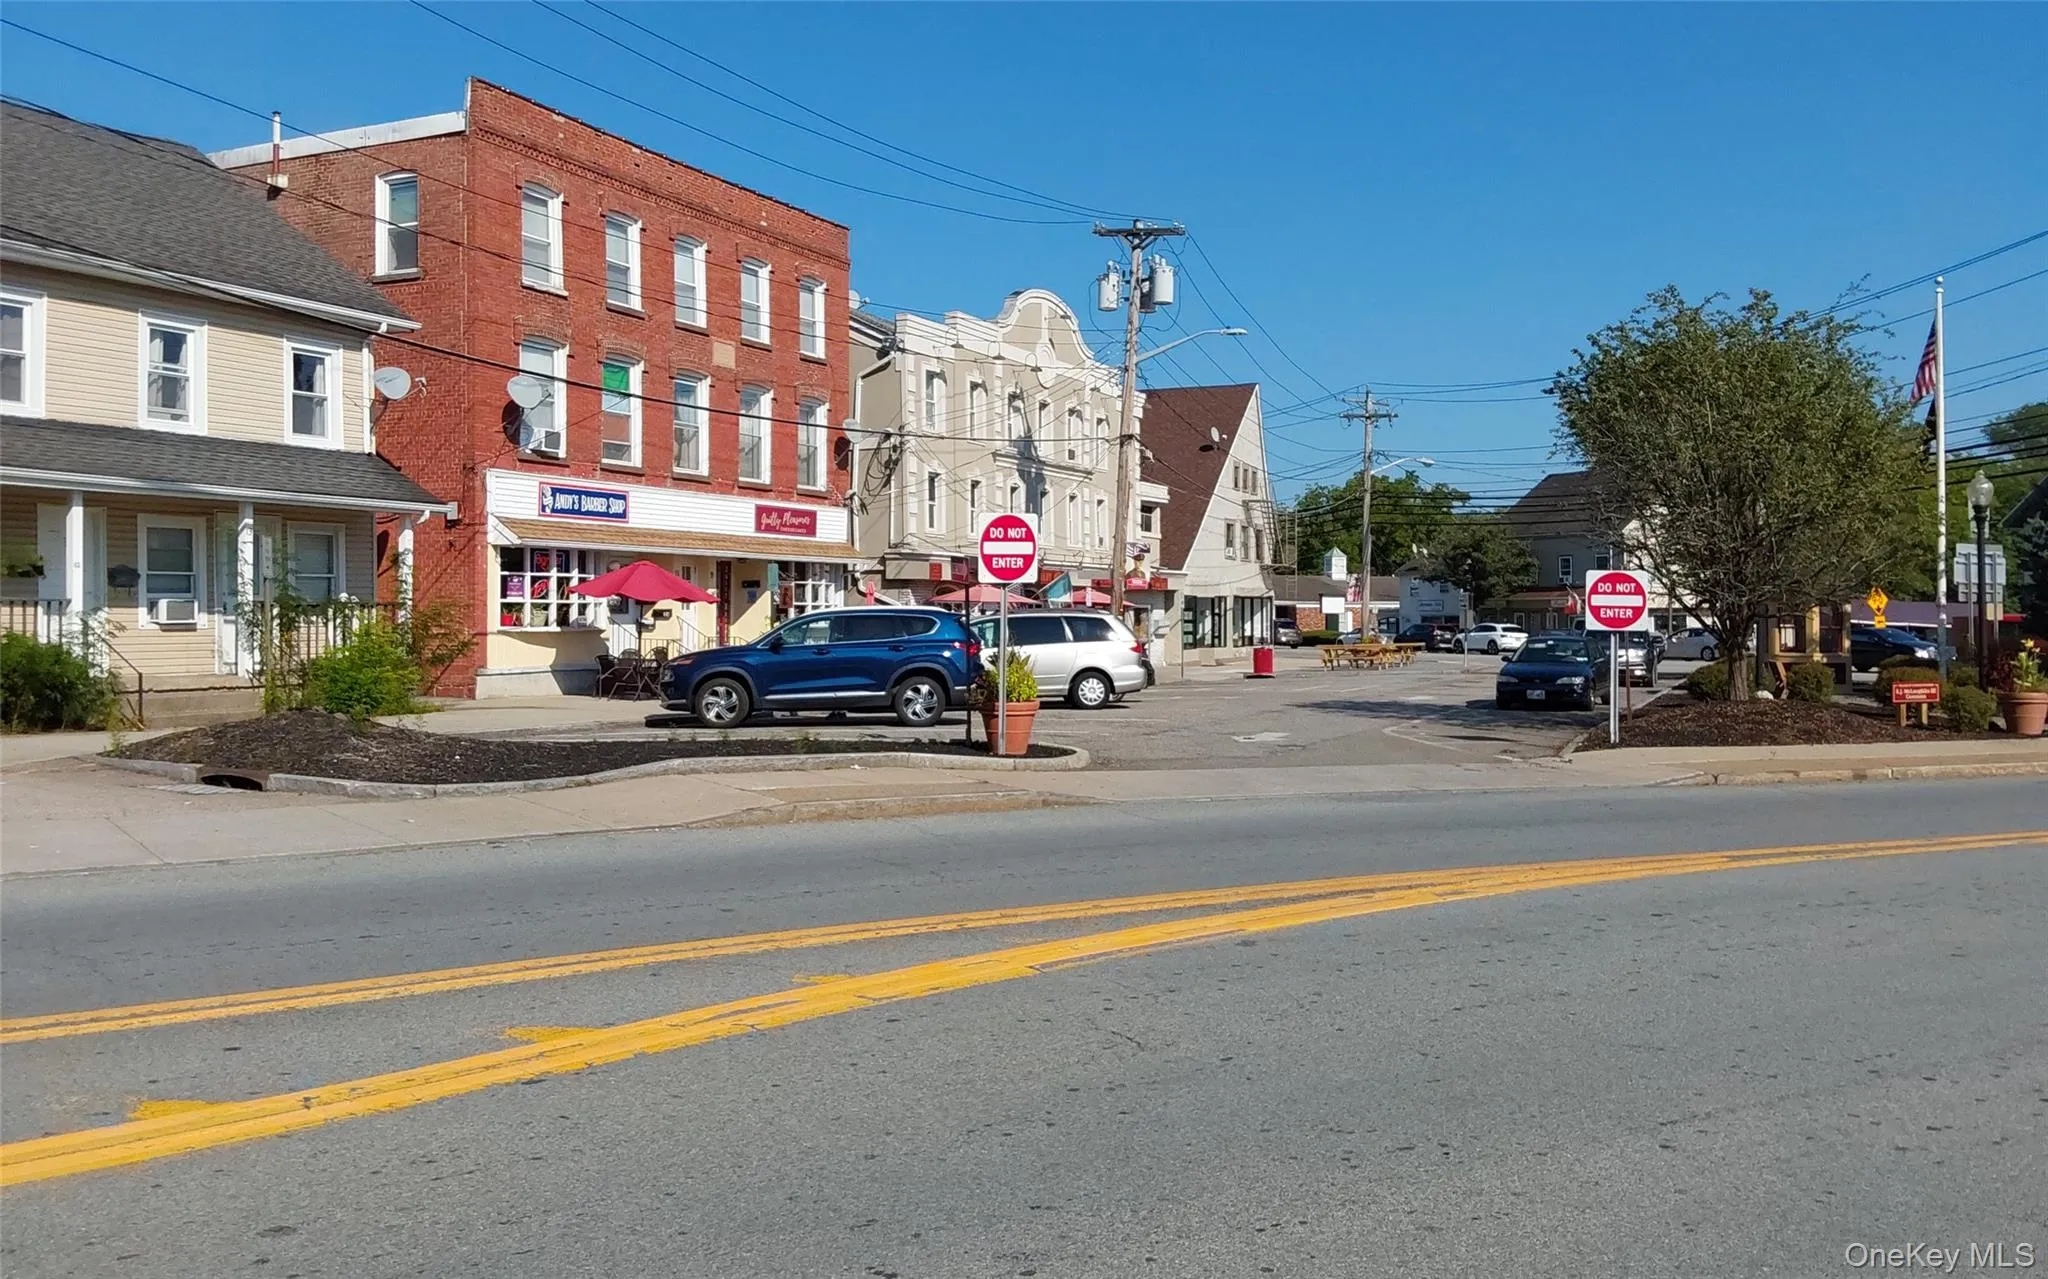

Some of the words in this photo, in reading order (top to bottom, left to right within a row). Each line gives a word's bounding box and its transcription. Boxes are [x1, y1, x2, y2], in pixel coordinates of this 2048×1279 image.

[554, 492, 579, 510] ANDY'S
[581, 495, 608, 512] BARBER
[608, 497, 626, 514] SHOP
[989, 527, 1004, 539] DO
[1007, 527, 1027, 539] NOT
[992, 557, 1024, 569] ENTER
[1597, 582, 1612, 593] DO
[1616, 583, 1636, 593] NOT
[1600, 607, 1633, 618] ENTER
